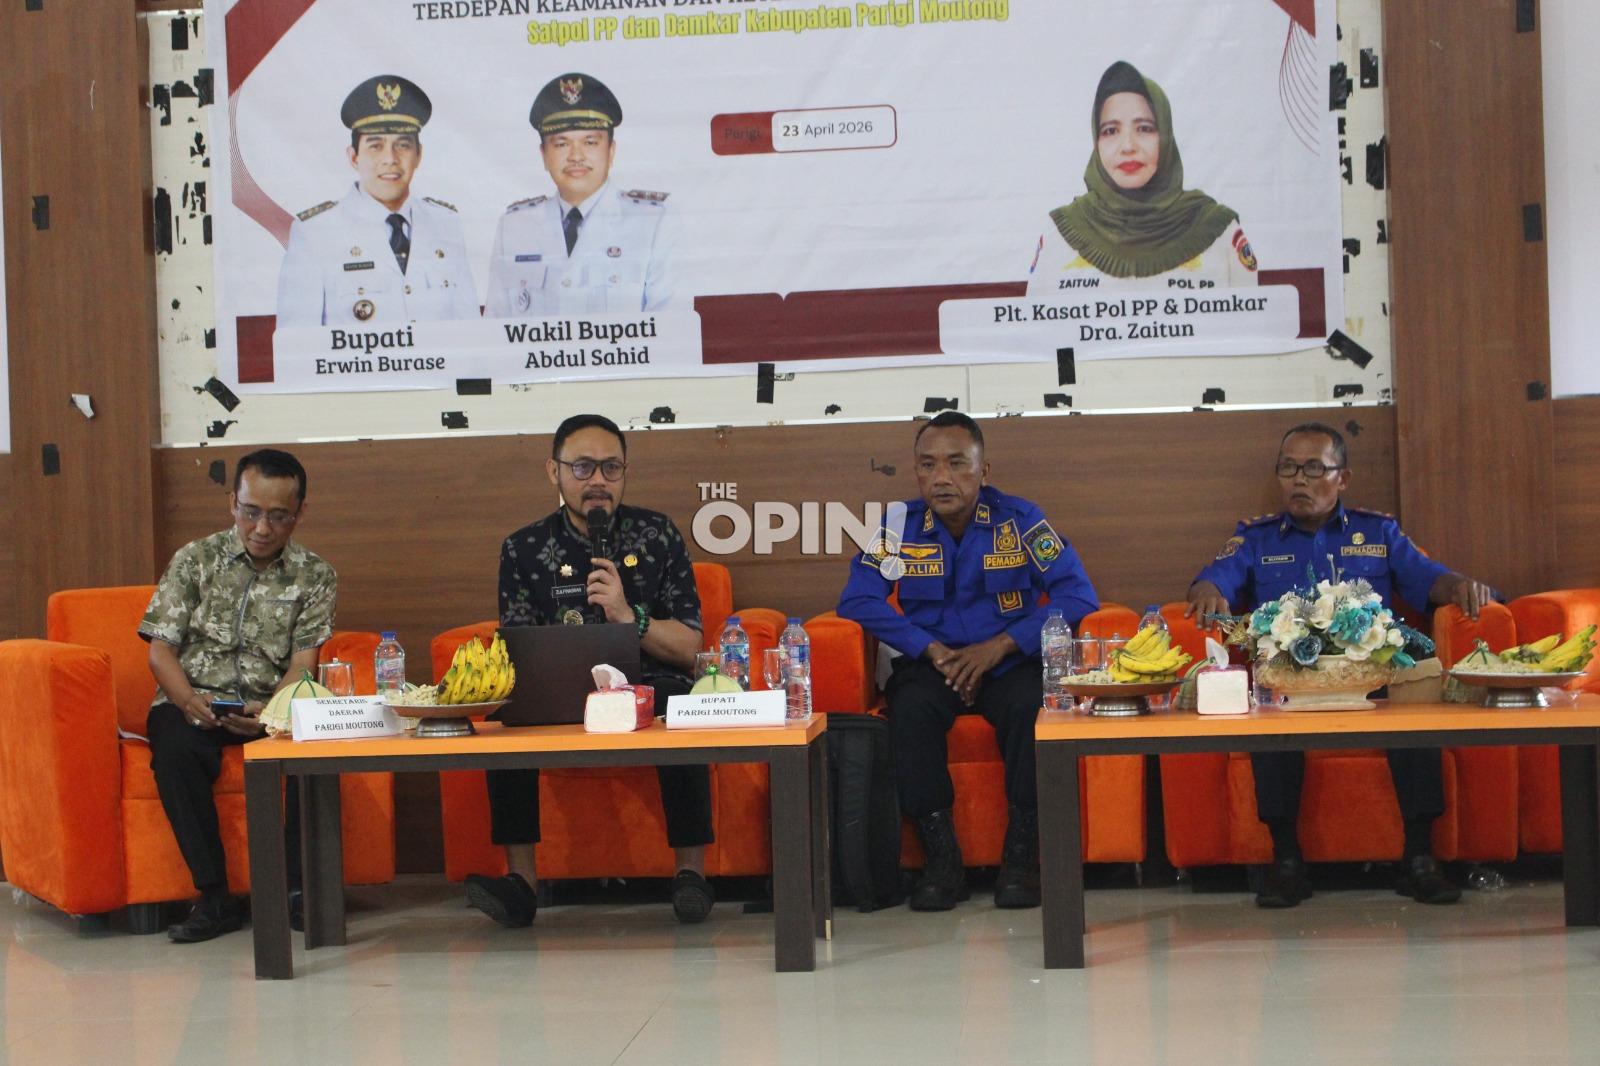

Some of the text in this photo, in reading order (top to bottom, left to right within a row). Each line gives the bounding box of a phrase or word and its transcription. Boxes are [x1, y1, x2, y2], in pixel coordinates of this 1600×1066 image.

[413, 0, 530, 20] TERDEPAN
[527, 0, 1009, 46] Satpol PP dan Damkar Kabupaten Parigi Moutong
[782, 125, 799, 137] 23
[804, 122, 834, 138] April
[838, 121, 873, 134] 2026
[1059, 278, 1100, 289] ZAITUN
[1168, 278, 1195, 289] POL
[994, 294, 1268, 322] Plt. Kasat Pol PP & Damkar
[331, 325, 415, 354] Bupati
[504, 317, 657, 346] Wakil Bupati
[1079, 321, 1195, 341] Dra. Zaitun
[315, 355, 446, 375] Erwin Burase
[525, 347, 650, 368] Abdul Sahid
[701, 696, 736, 704] BUPATI
[329, 708, 364, 716] DAERAH
[713, 708, 757, 716] MOUTONG
[315, 721, 384, 731] PARIGI MOUTONG
